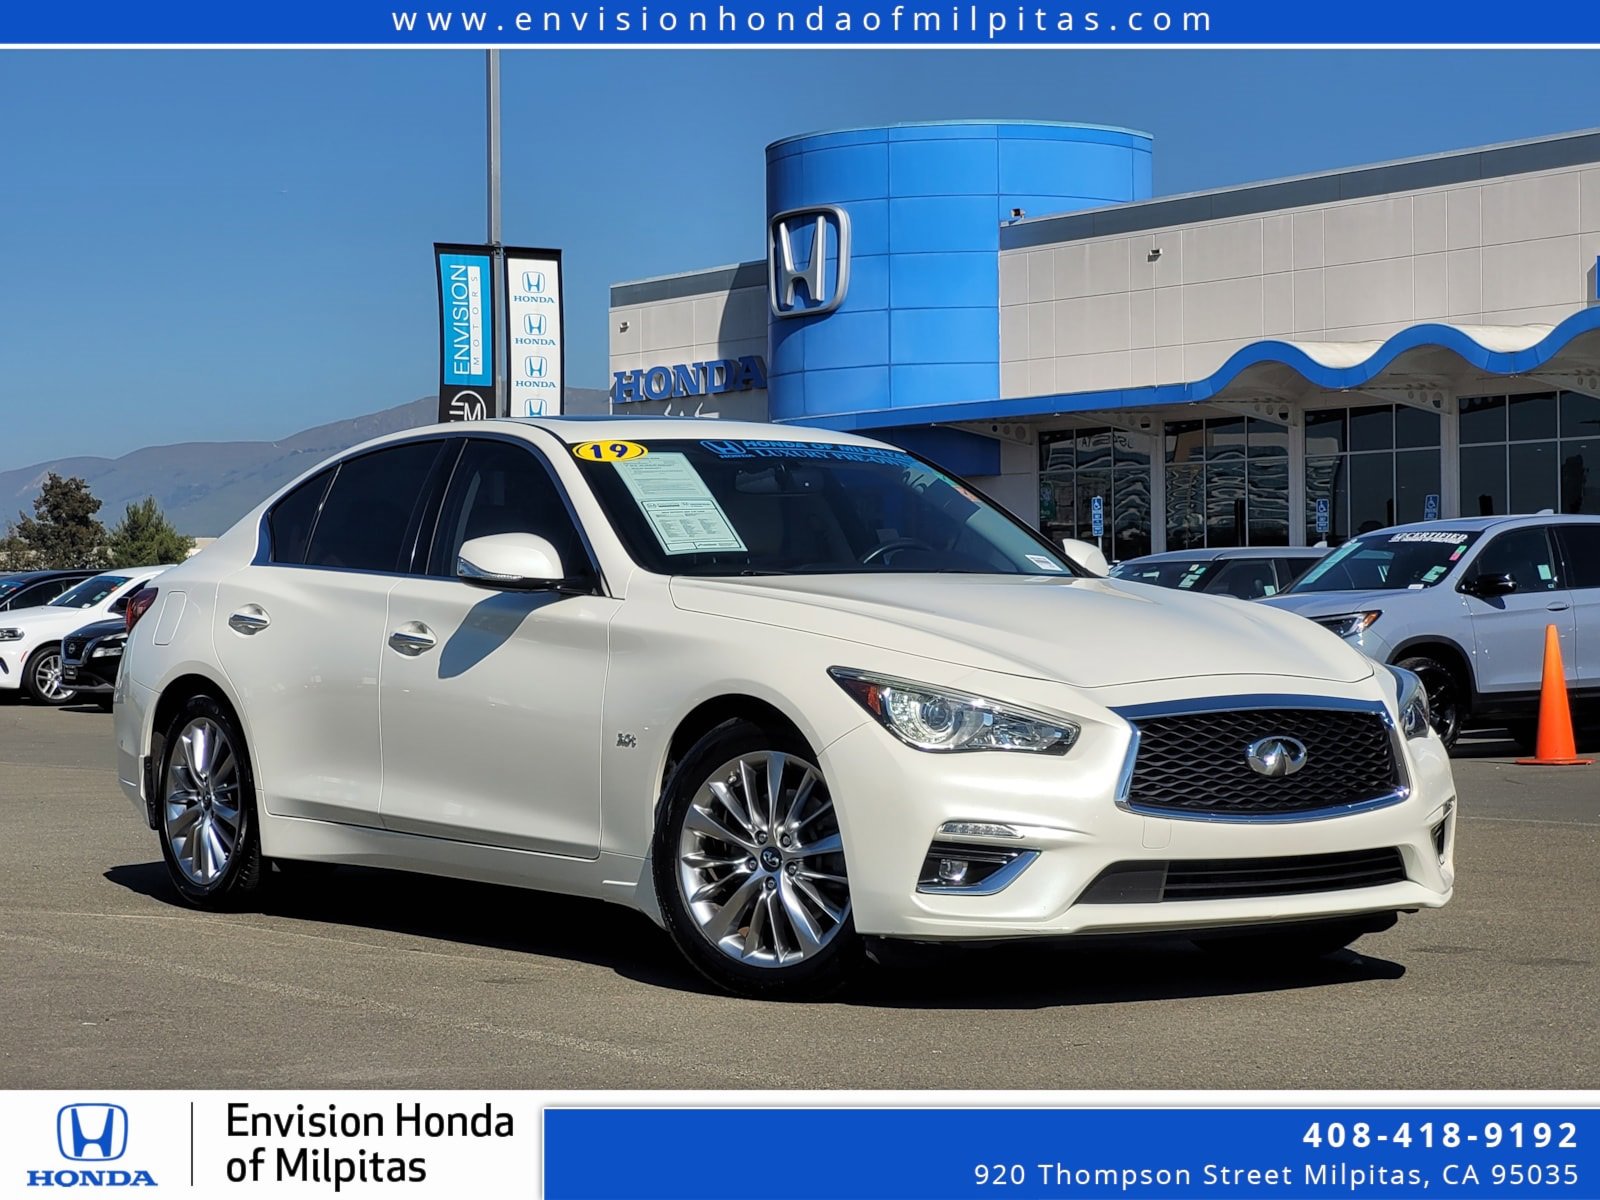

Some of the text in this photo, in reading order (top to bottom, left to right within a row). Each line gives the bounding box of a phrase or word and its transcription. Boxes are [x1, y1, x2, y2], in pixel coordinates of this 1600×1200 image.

[513, 295, 555, 303] HONDA
[449, 264, 470, 374] ENVISION
[470, 275, 481, 366] MOTORS
[514, 337, 556, 346] HONDA
[514, 380, 556, 388] HONDA
[613, 356, 766, 404] HONDA
[741, 440, 809, 449] HONDA
[810, 441, 833, 450] OF
[589, 444, 628, 458] 19
[754, 449, 829, 459] LUXURY
[1404, 532, 1468, 542] CERTIFIED
